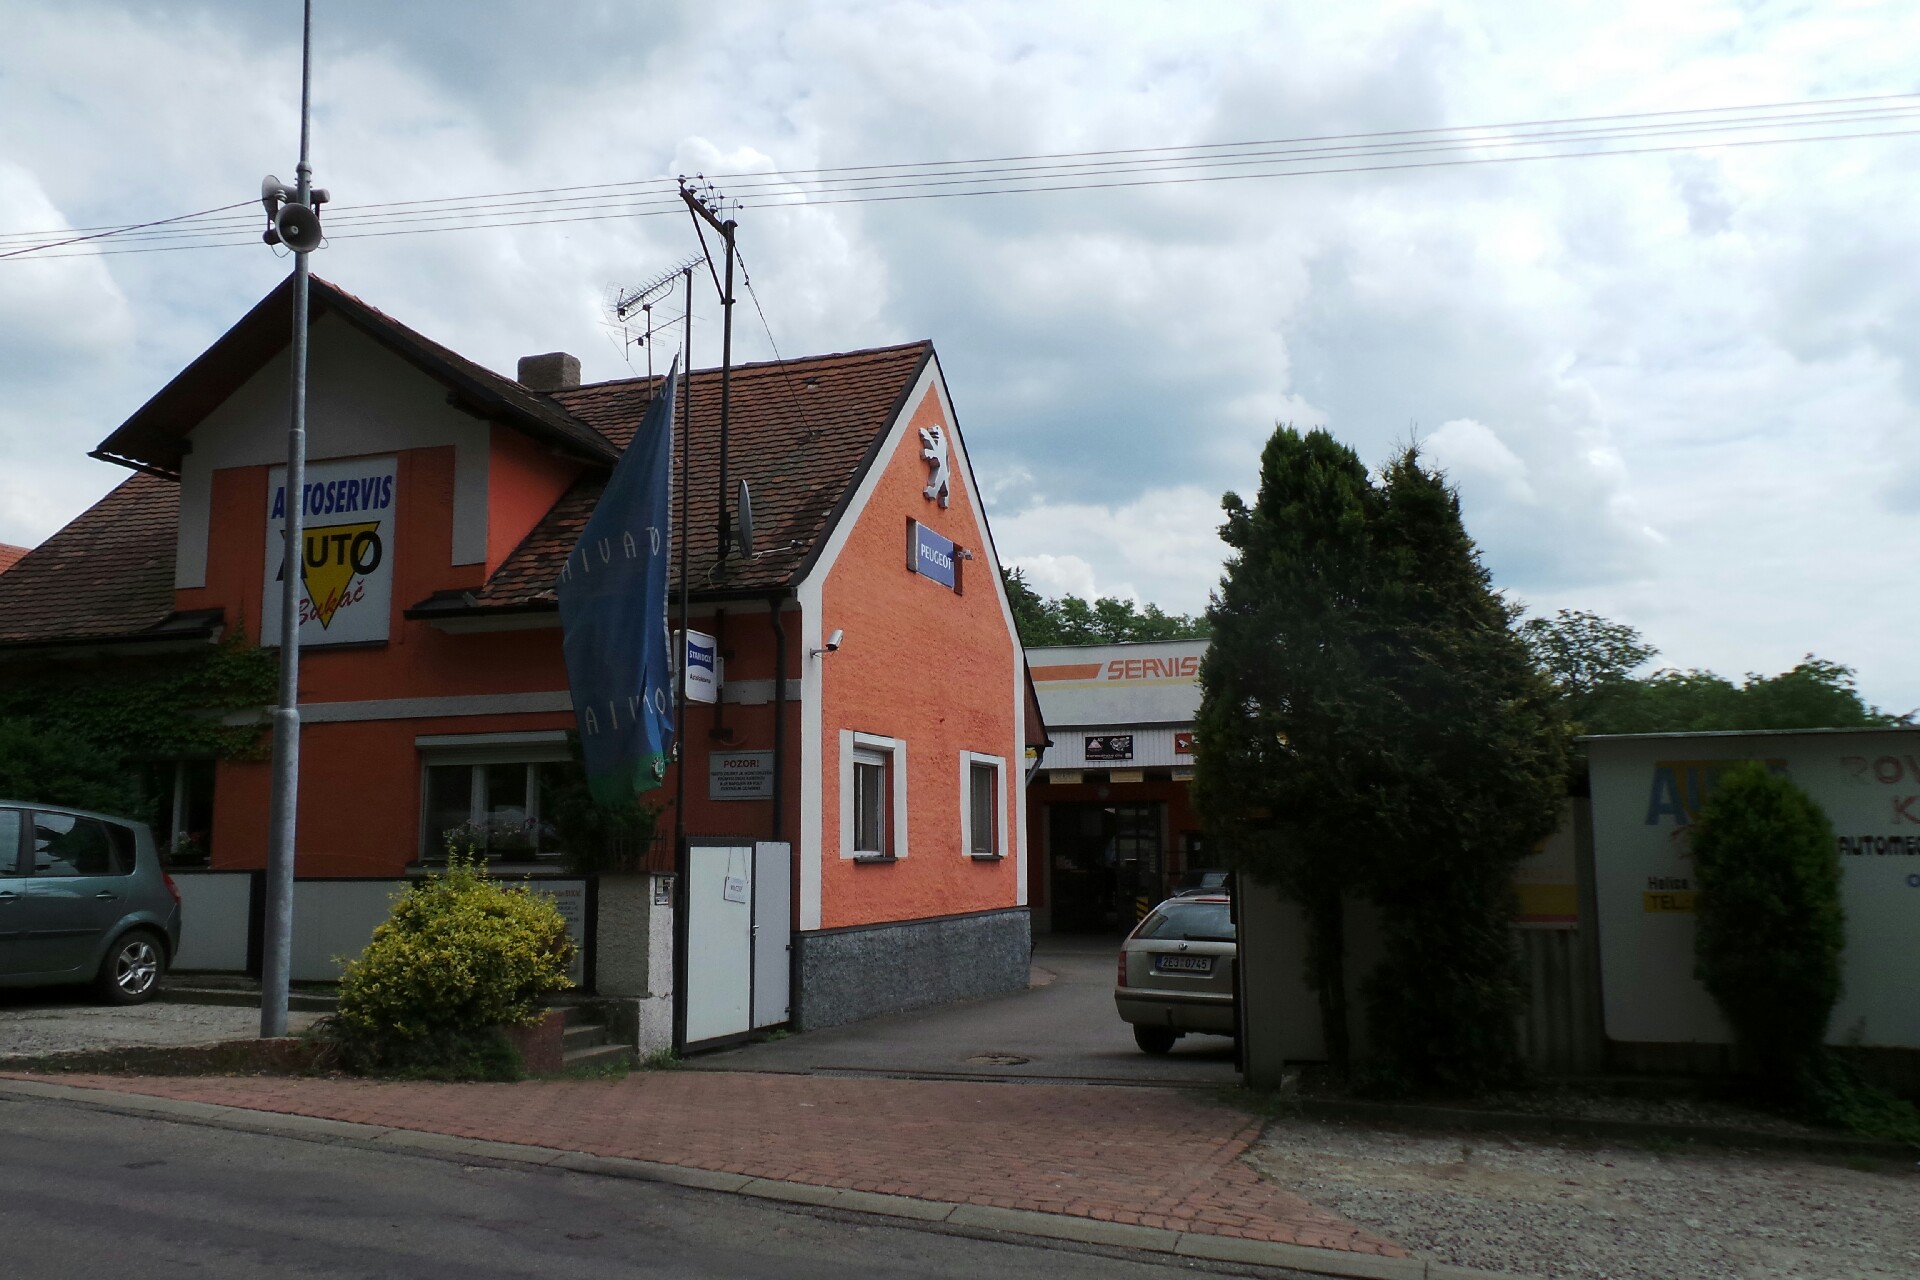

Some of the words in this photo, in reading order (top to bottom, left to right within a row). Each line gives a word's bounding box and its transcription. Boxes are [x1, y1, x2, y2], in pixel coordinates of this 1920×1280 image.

[271, 475, 392, 519] ATOSERVIS
[920, 543, 952, 570] PEUGEOT
[689, 650, 712, 664] STANDOX
[1107, 656, 1198, 680] SERVIS
[723, 759, 760, 768] POZOR!
[1839, 835, 1920, 855] AUTOME
[1185, 958, 1207, 970] 0745
